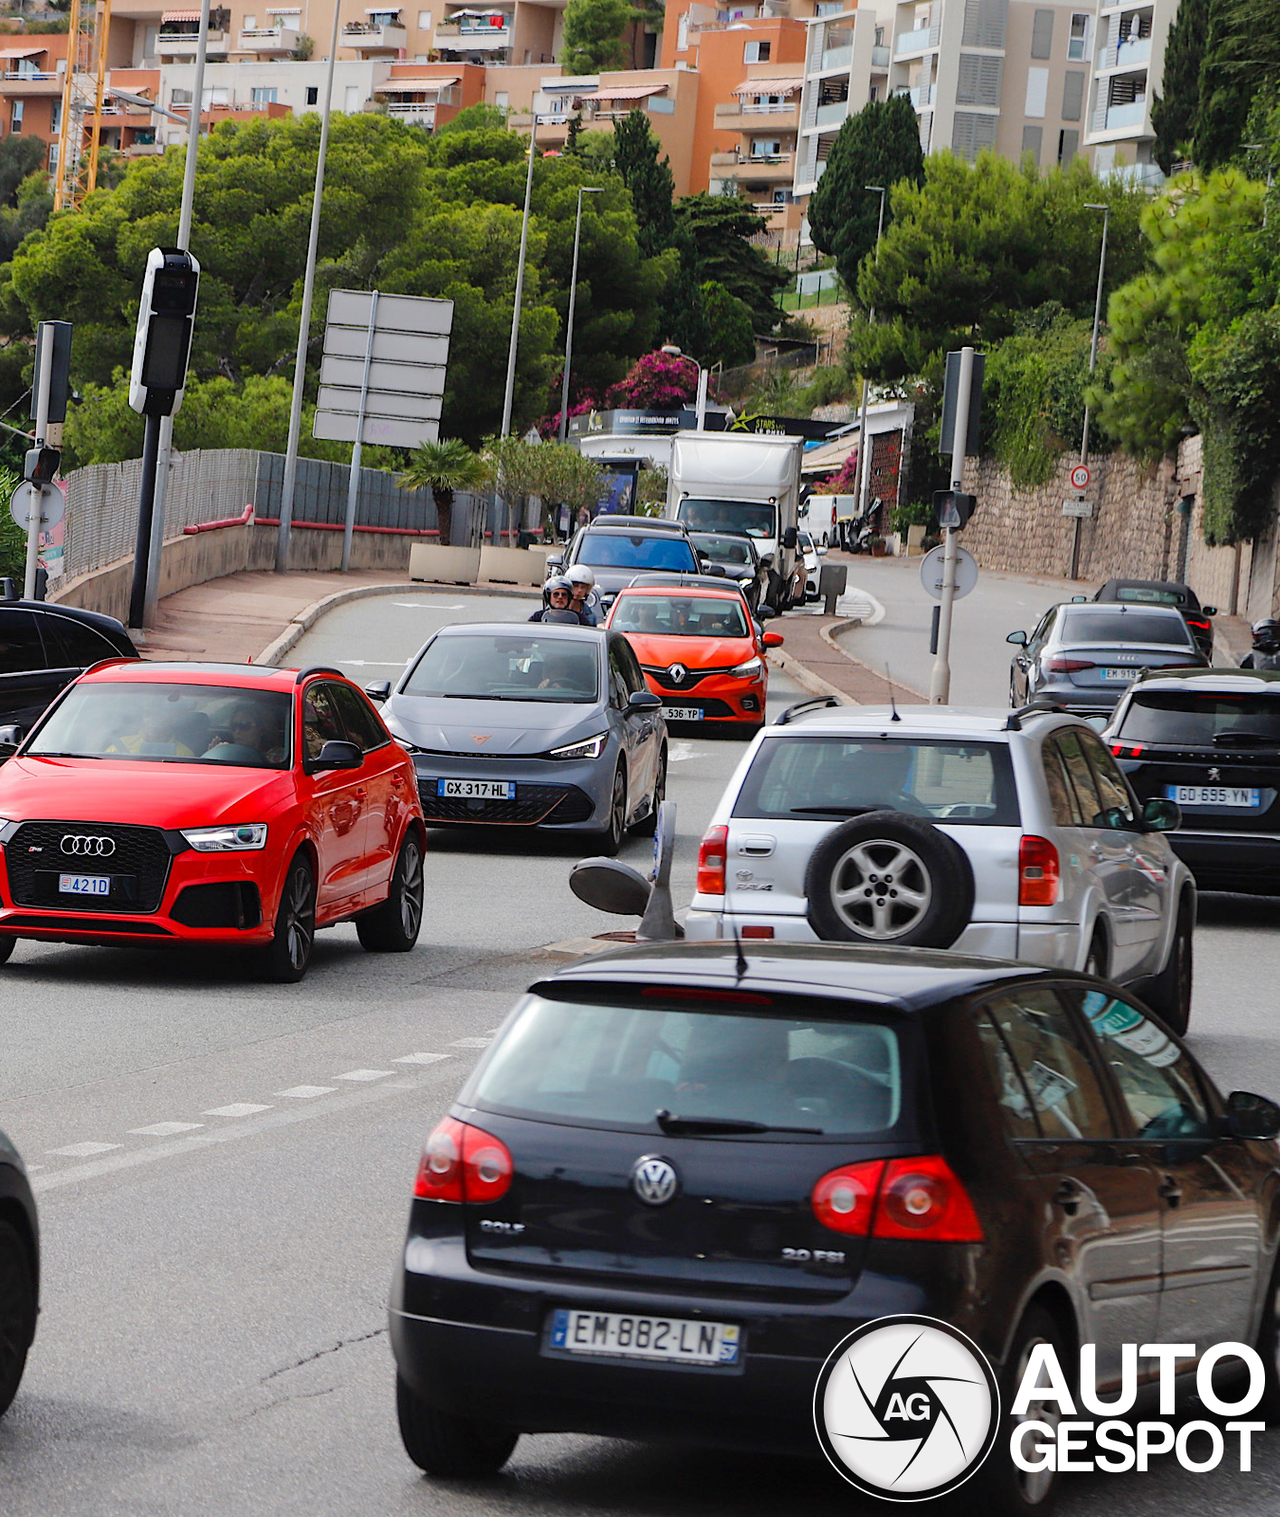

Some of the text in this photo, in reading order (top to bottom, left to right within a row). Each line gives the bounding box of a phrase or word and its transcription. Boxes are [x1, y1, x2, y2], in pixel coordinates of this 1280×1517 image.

[755, 419, 776, 430] STARS
[1075, 473, 1087, 482] 50
[447, 782, 507, 797] GX-317-HL
[1179, 788, 1249, 803] GD-695-YN
[72, 878, 107, 893] 421D
[574, 1314, 717, 1355] EM-882-LN
